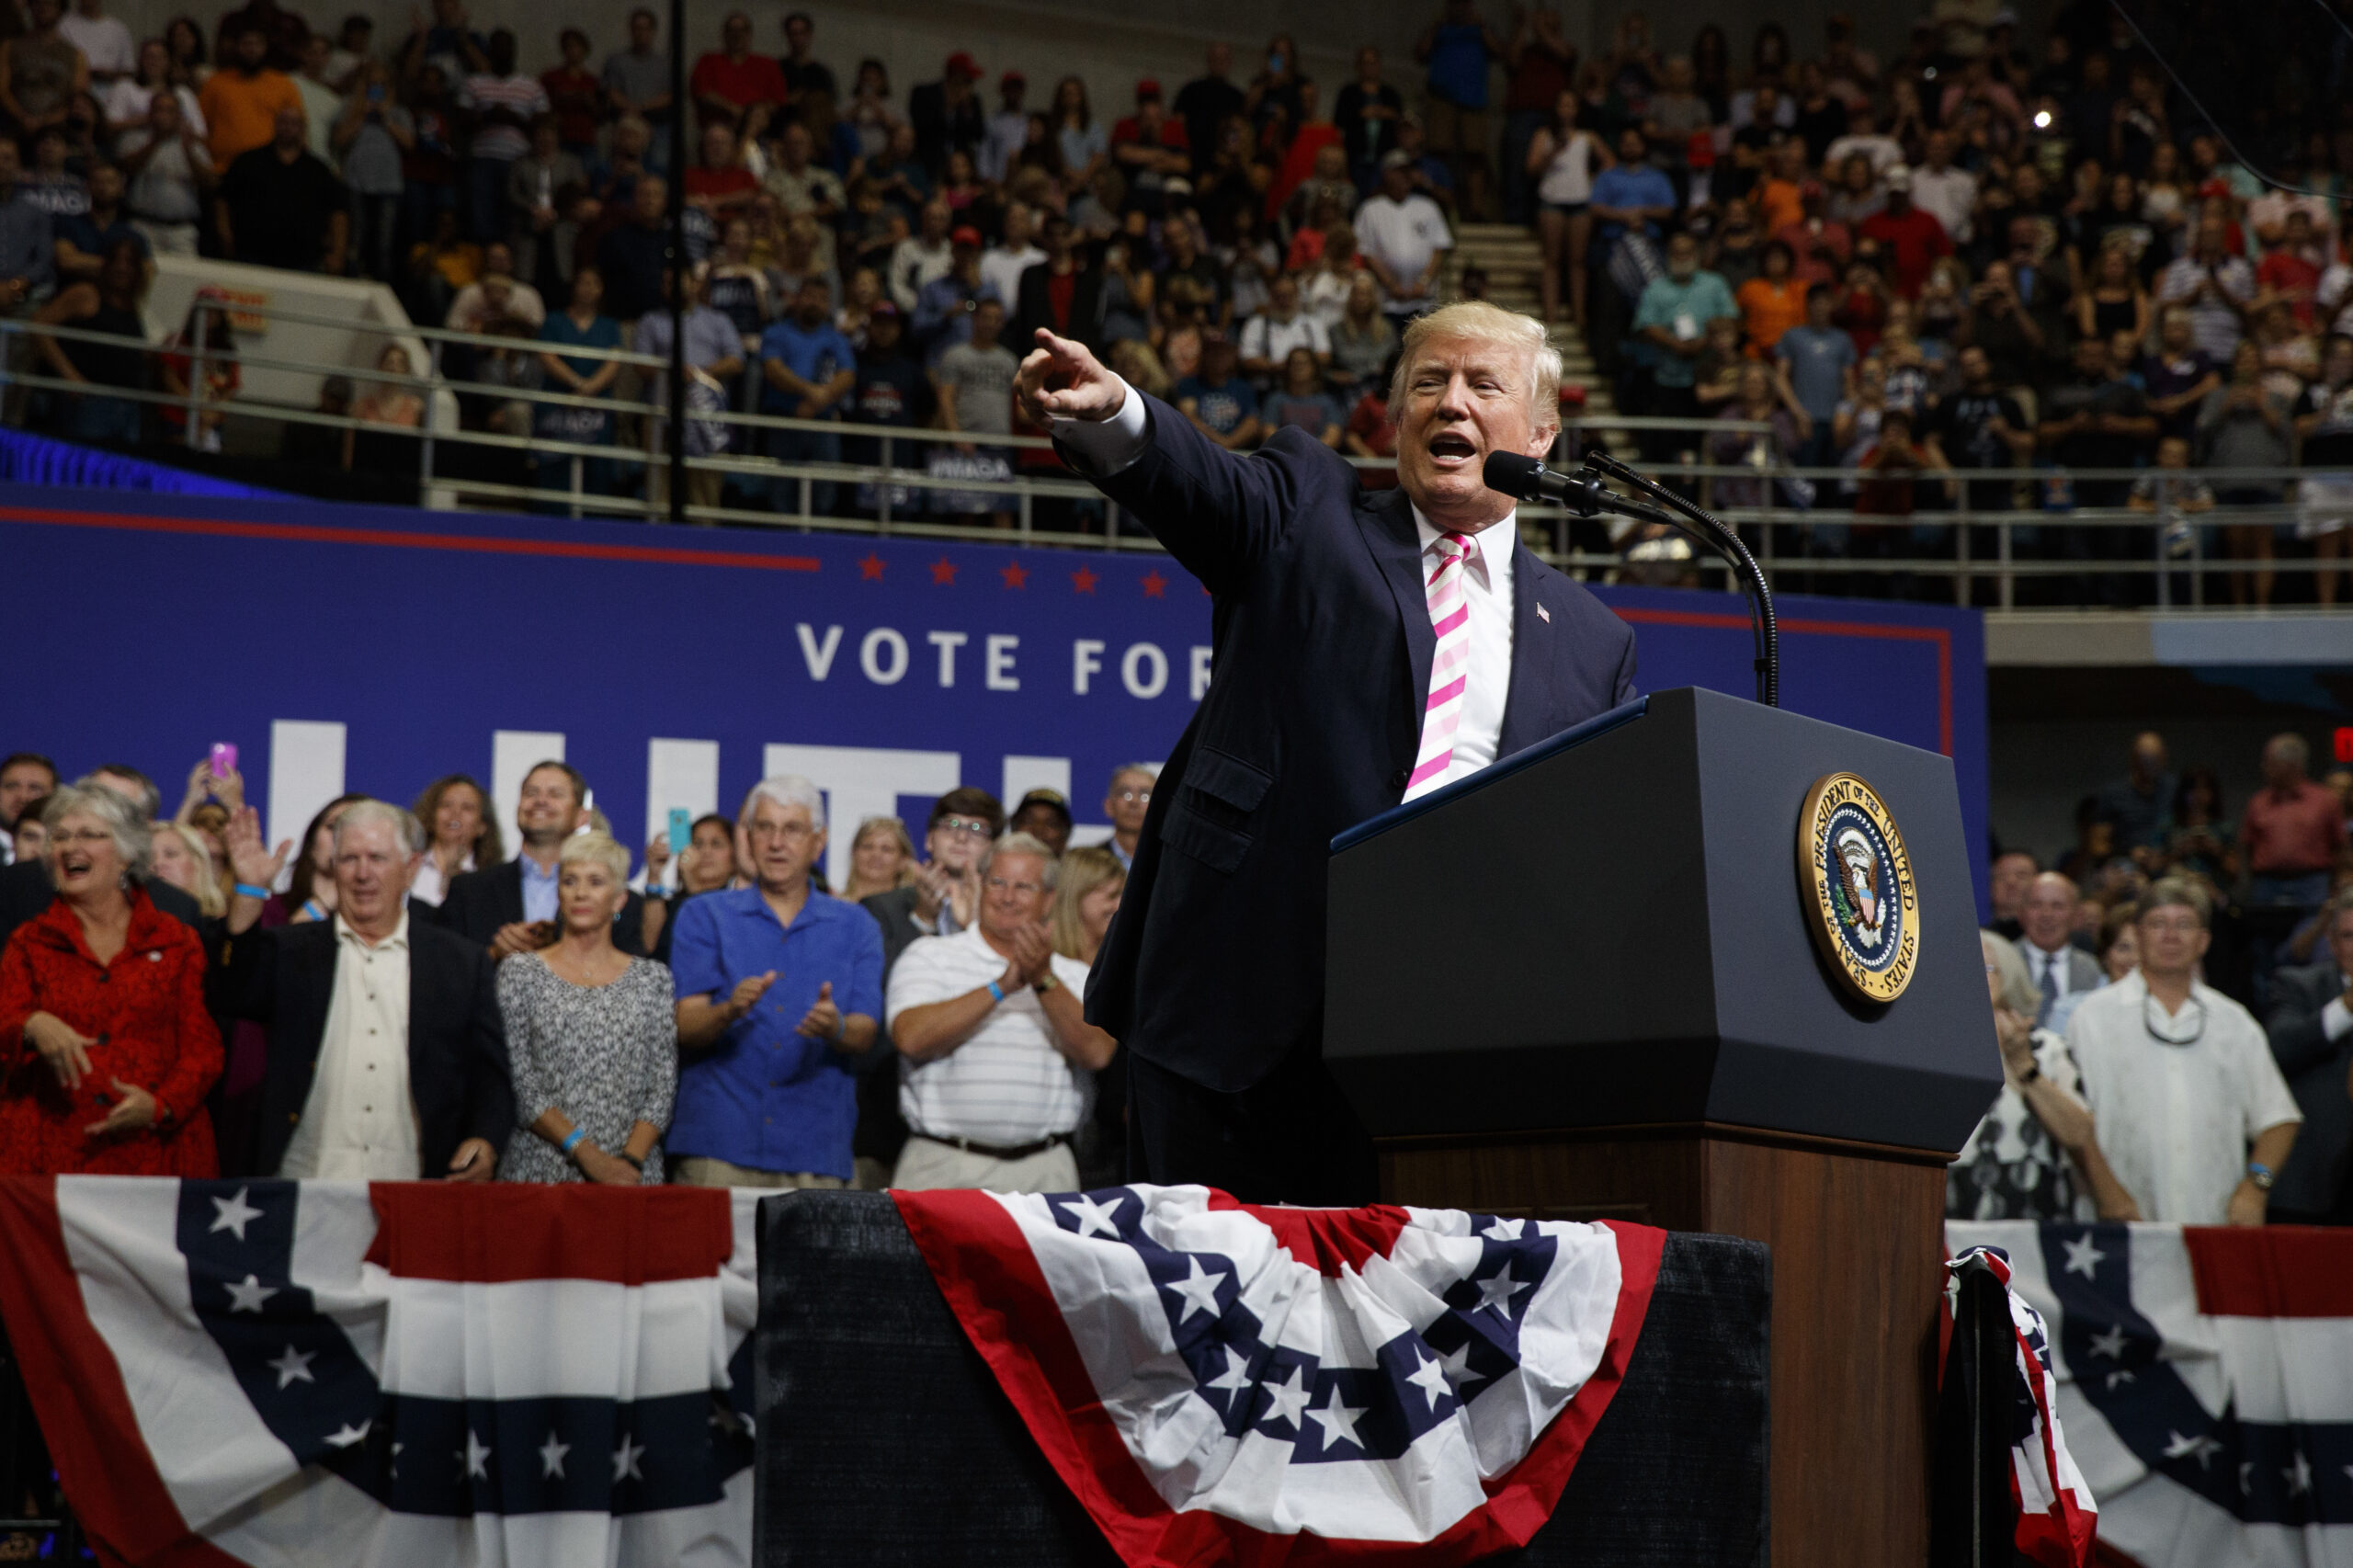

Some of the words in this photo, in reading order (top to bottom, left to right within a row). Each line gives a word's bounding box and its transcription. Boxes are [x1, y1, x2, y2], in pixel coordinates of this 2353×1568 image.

[796, 623, 1020, 691] VOTE
[1853, 785, 1864, 801] OF
[1864, 792, 1880, 817] THE
[1814, 780, 1850, 868] PRESIDENT
[1882, 816, 1914, 911] UNITED
[1819, 880, 1828, 910] THE
[1837, 936, 1867, 987] SEAL
[1884, 929, 1915, 994] STATES
